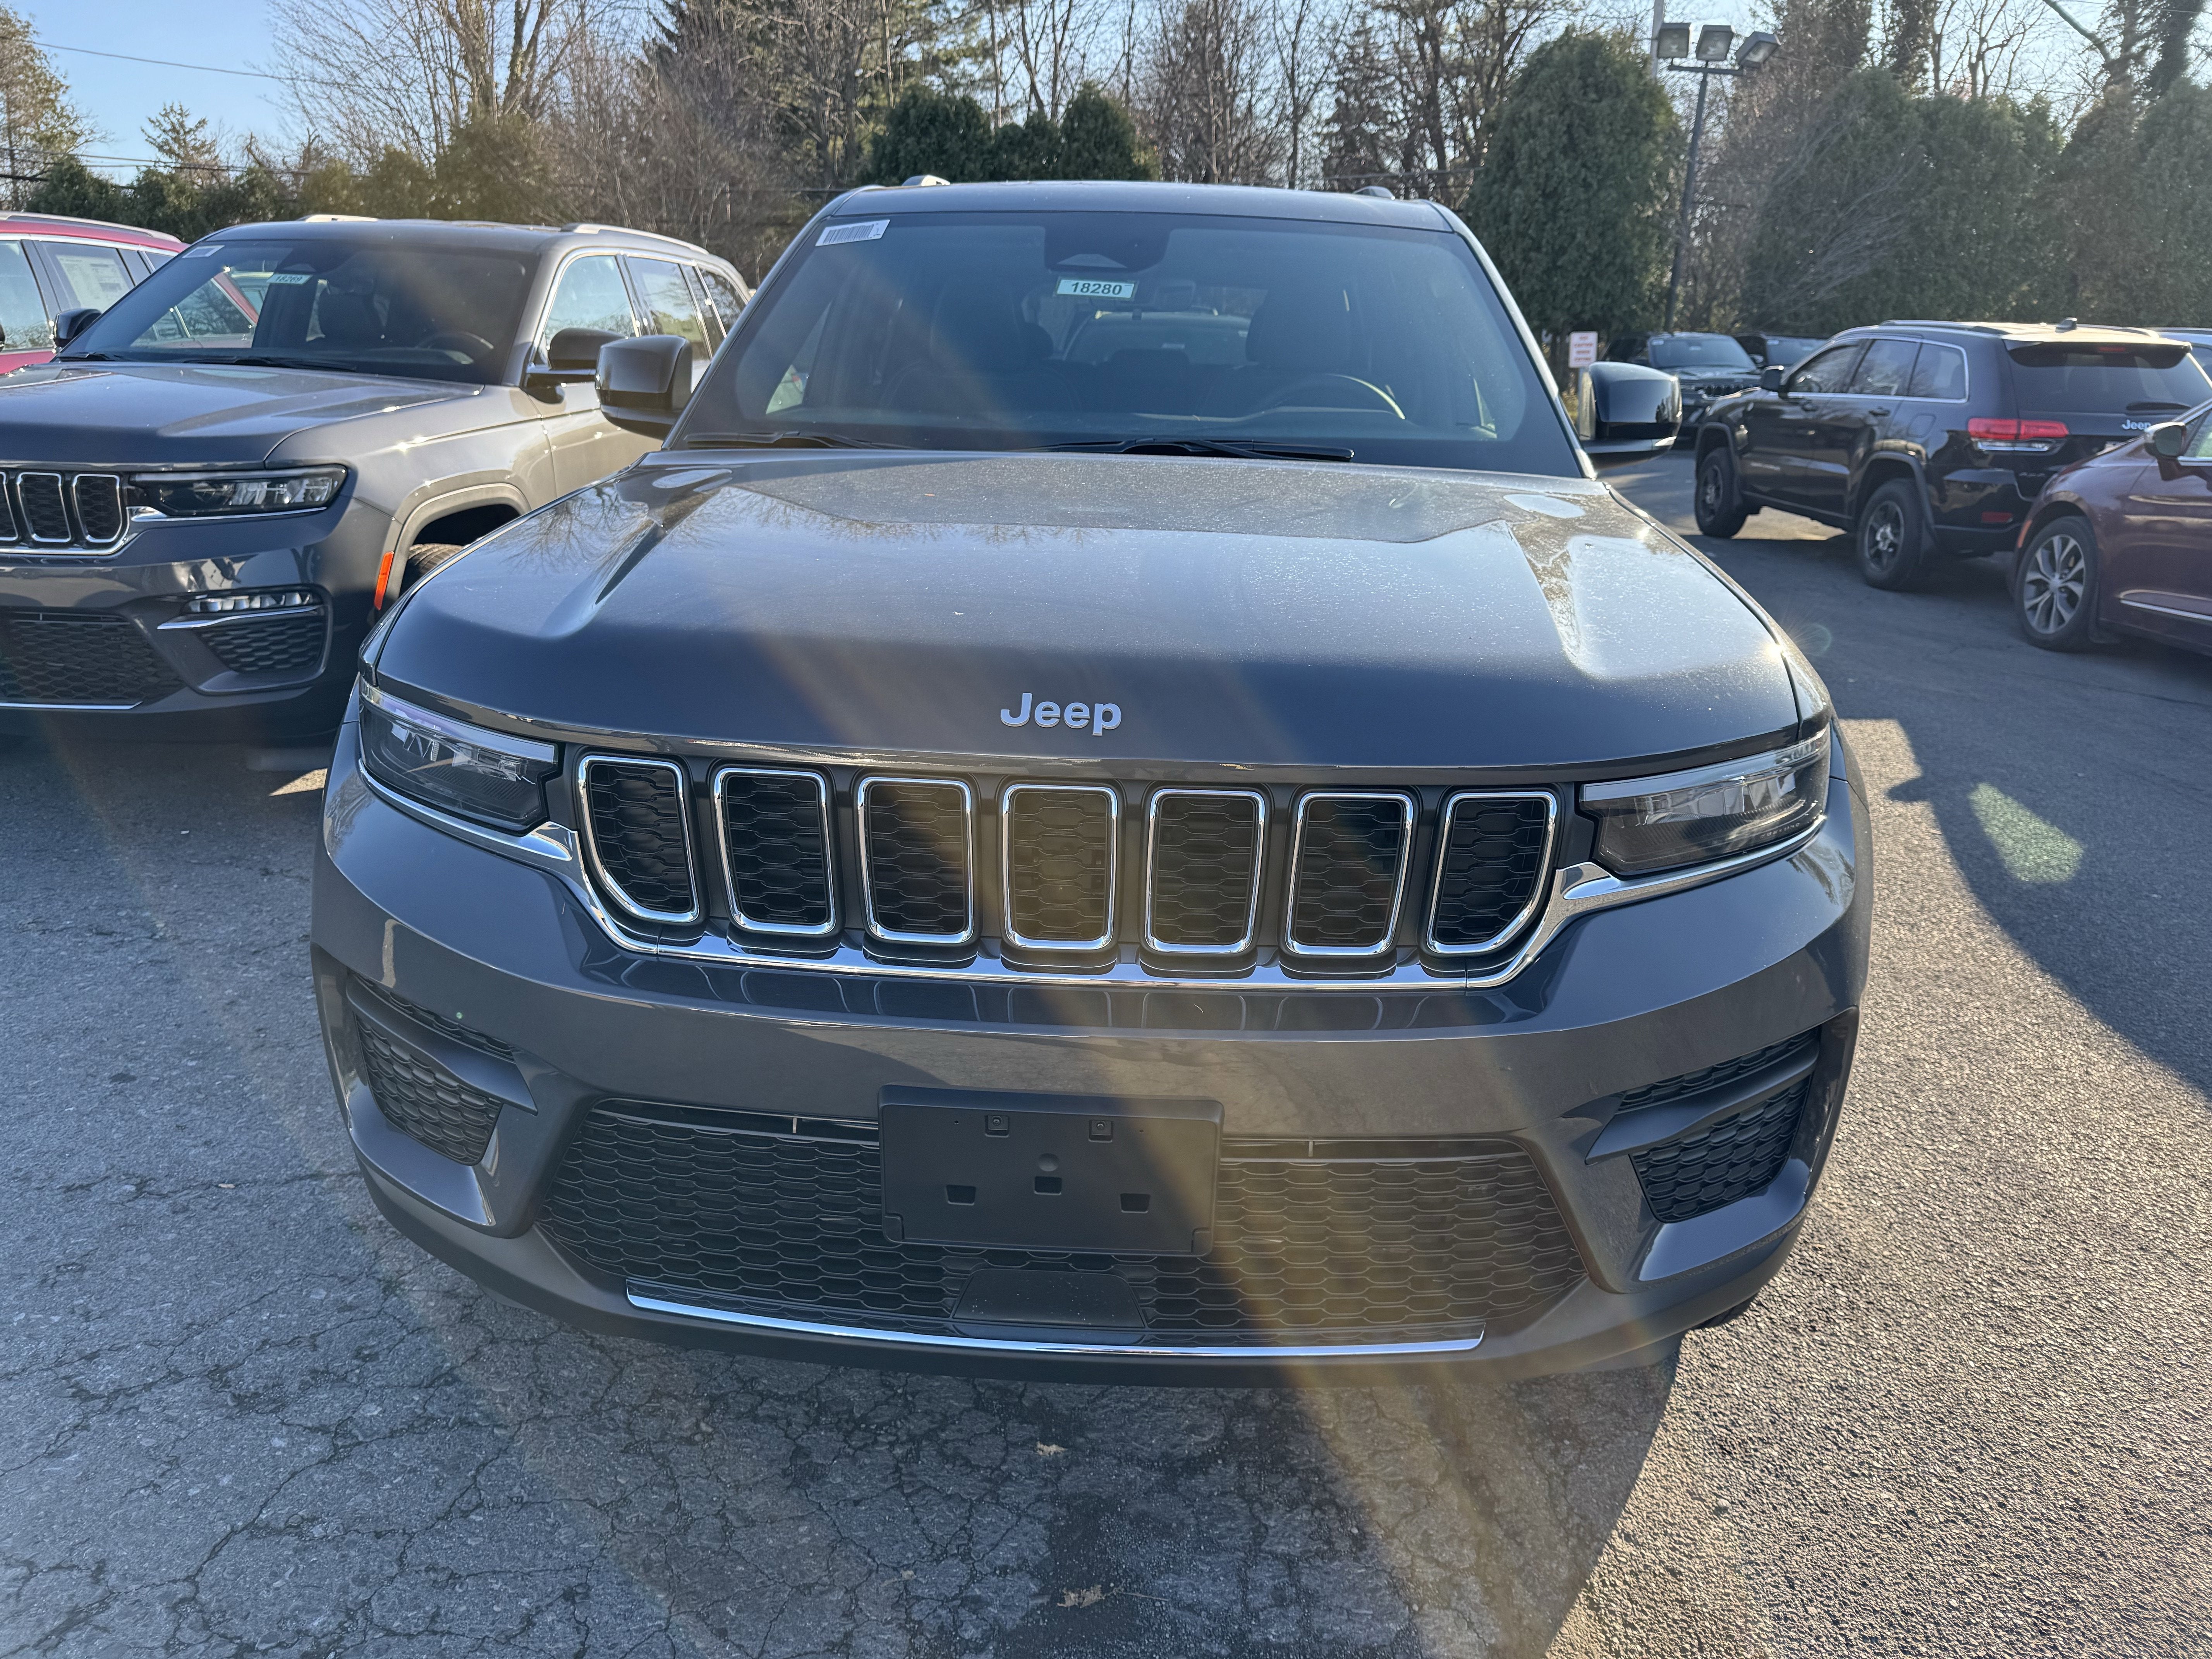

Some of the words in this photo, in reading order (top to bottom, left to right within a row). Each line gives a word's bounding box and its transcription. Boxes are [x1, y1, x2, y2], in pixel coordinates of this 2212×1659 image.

[1072, 282, 1122, 295] 18280
[2122, 419, 2151, 432] Jeep
[1000, 692, 1122, 737] Jeep
